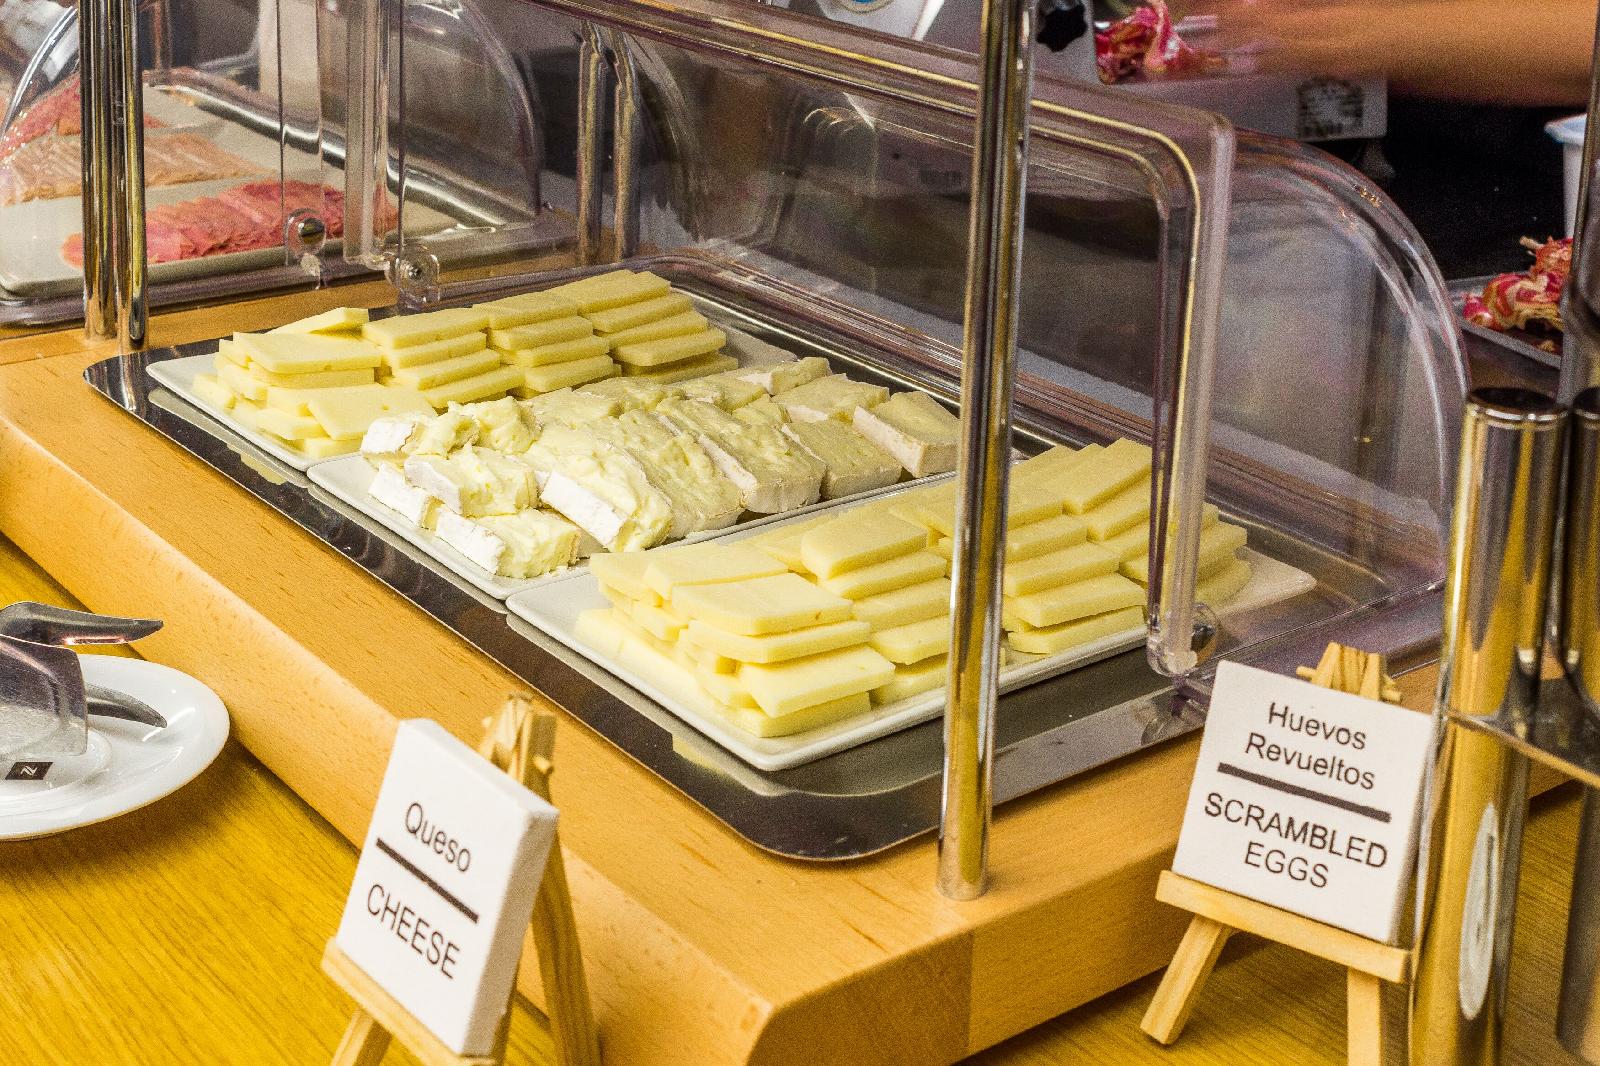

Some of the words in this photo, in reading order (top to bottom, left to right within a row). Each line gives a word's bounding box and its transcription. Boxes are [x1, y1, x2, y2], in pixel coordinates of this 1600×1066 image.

[1268, 702, 1367, 750] Huevos
[1244, 732, 1375, 790] Revueltos
[405, 802, 471, 872] Queso
[1204, 792, 1388, 868] SCRAMBLED
[1244, 841, 1329, 888] EGGS
[367, 884, 460, 979] CHEESE
